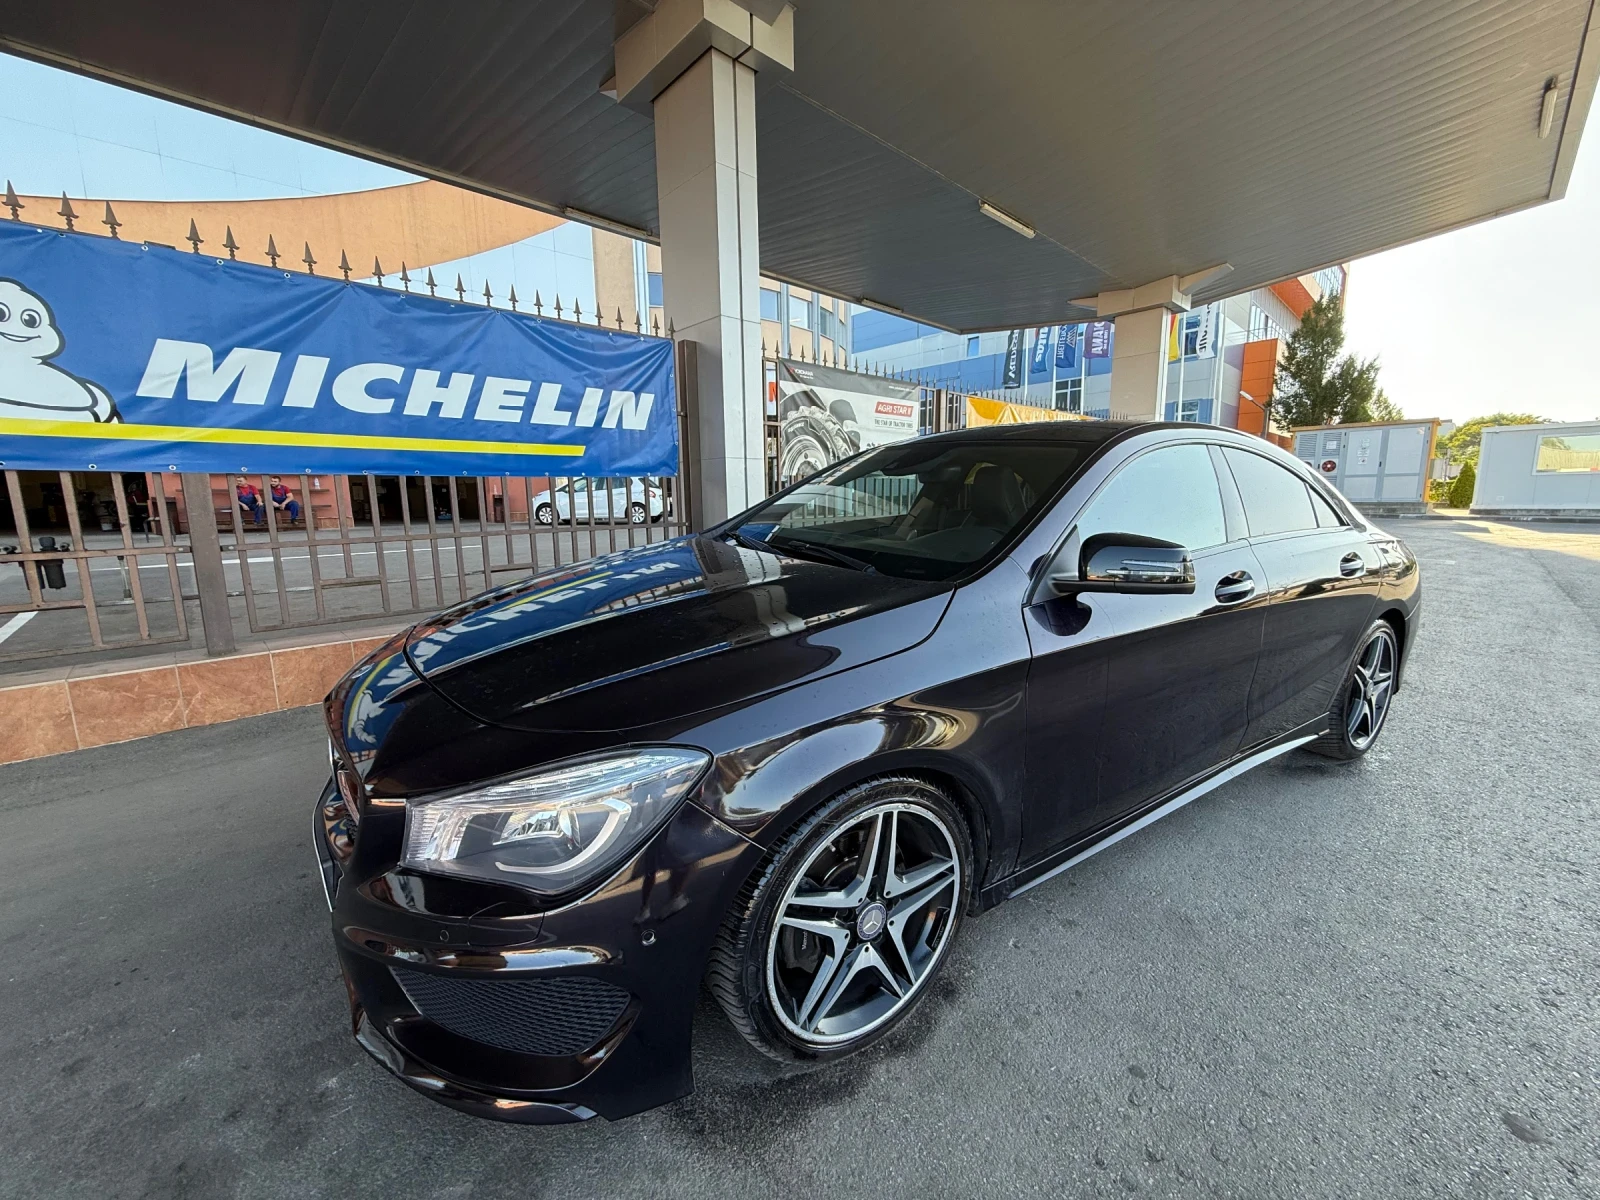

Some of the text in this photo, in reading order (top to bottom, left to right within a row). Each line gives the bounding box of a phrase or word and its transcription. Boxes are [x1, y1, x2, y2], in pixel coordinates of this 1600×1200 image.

[136, 338, 654, 431] MICHELIN
[877, 403, 893, 413] AGRI
[893, 405, 908, 415] STAR
